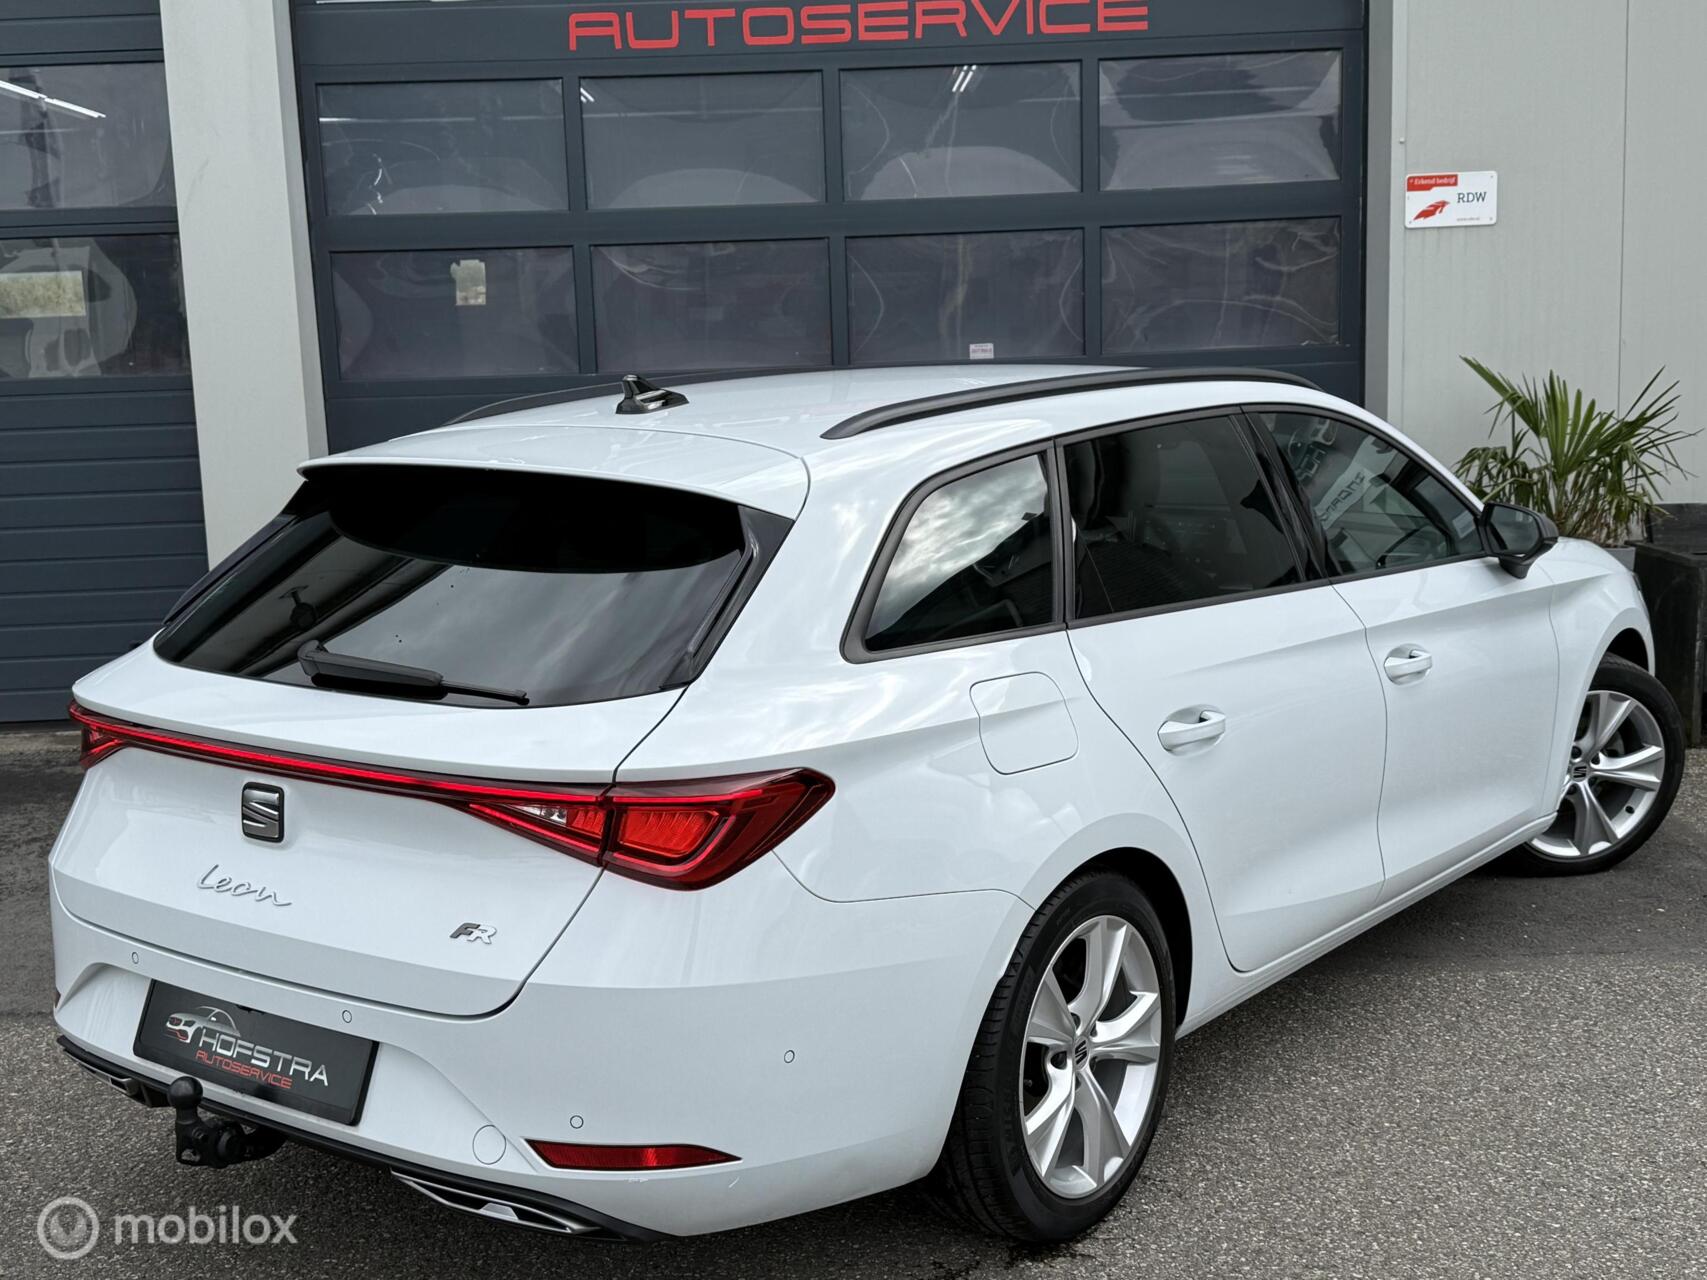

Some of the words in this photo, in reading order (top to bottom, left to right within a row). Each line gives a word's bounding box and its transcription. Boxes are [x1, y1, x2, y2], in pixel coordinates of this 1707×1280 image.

[568, 0, 1149, 51] AUTOSERVICE
[1457, 191, 1488, 204] RDW
[196, 863, 293, 907] Leon
[449, 921, 498, 945] FR
[195, 1049, 294, 1089] AUTOSERVICE
[199, 1027, 329, 1087] HOFSTRA
